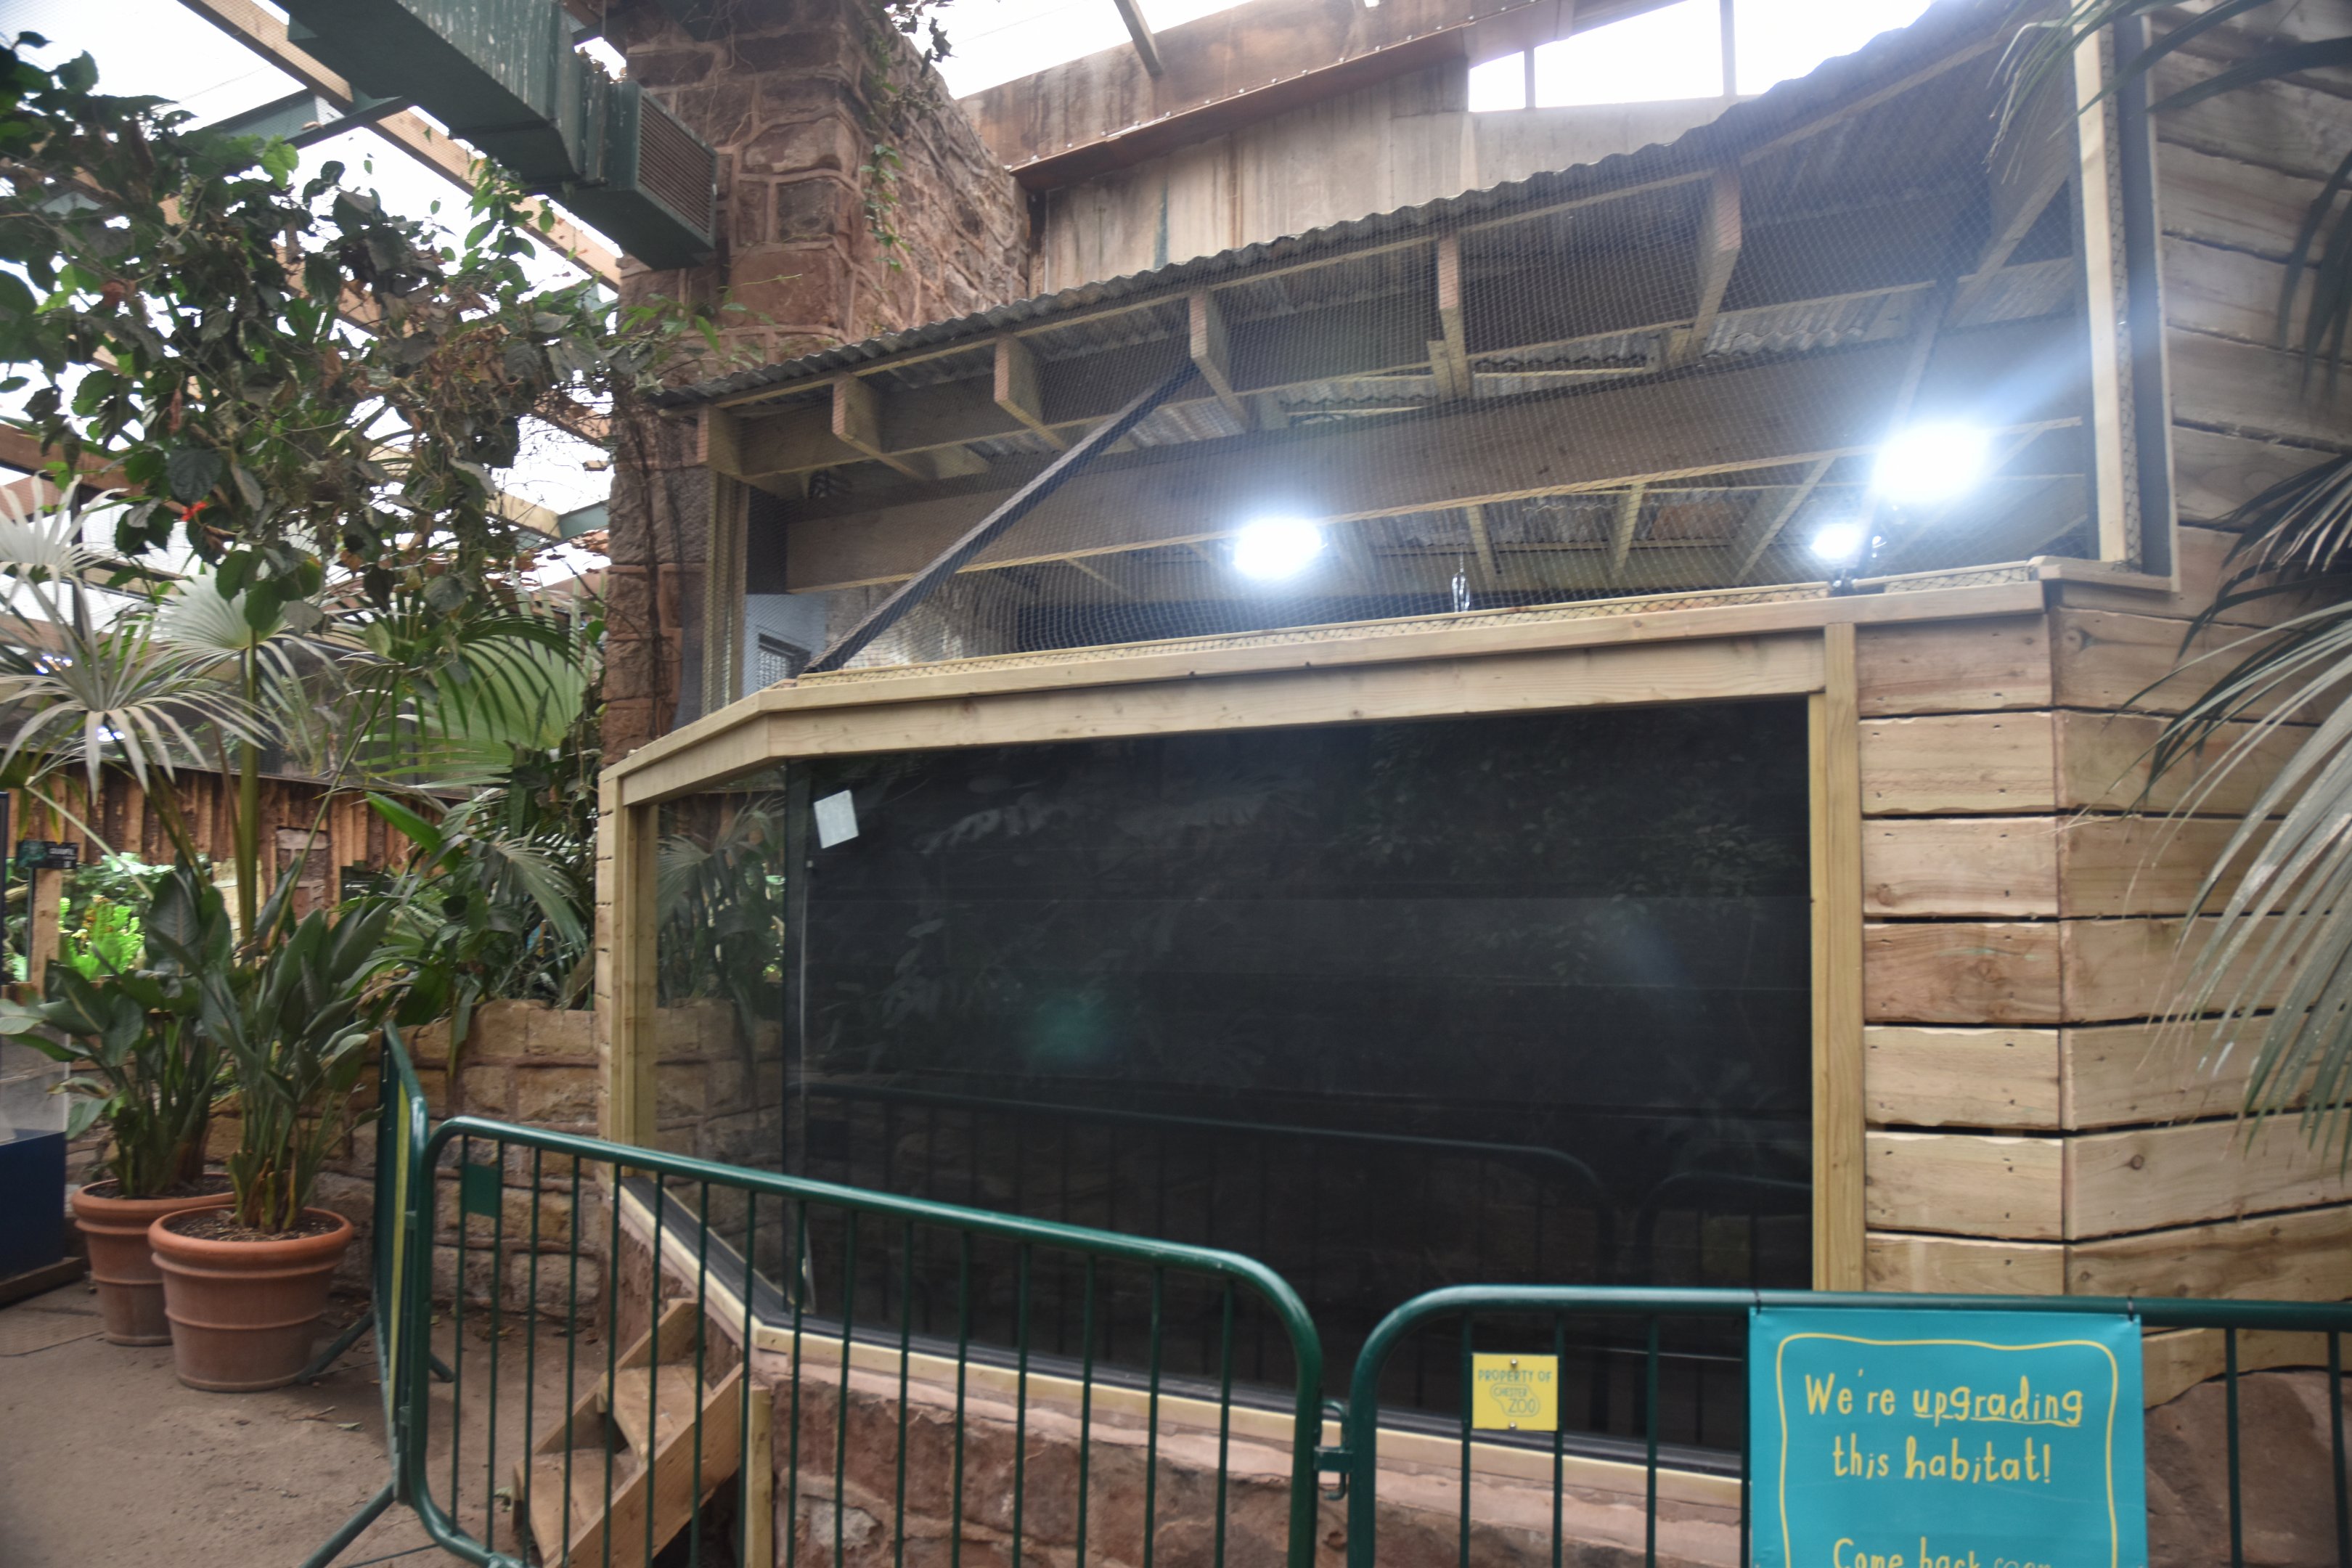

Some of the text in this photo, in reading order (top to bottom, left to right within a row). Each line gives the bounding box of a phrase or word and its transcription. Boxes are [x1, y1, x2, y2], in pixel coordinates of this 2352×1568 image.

[1478, 1369, 1553, 1382] PROPERTY OF
[1508, 1399, 1537, 1413] ZOO
[1805, 1368, 2083, 1427] We're upgrading
[1832, 1433, 2051, 1483] this habitat!
